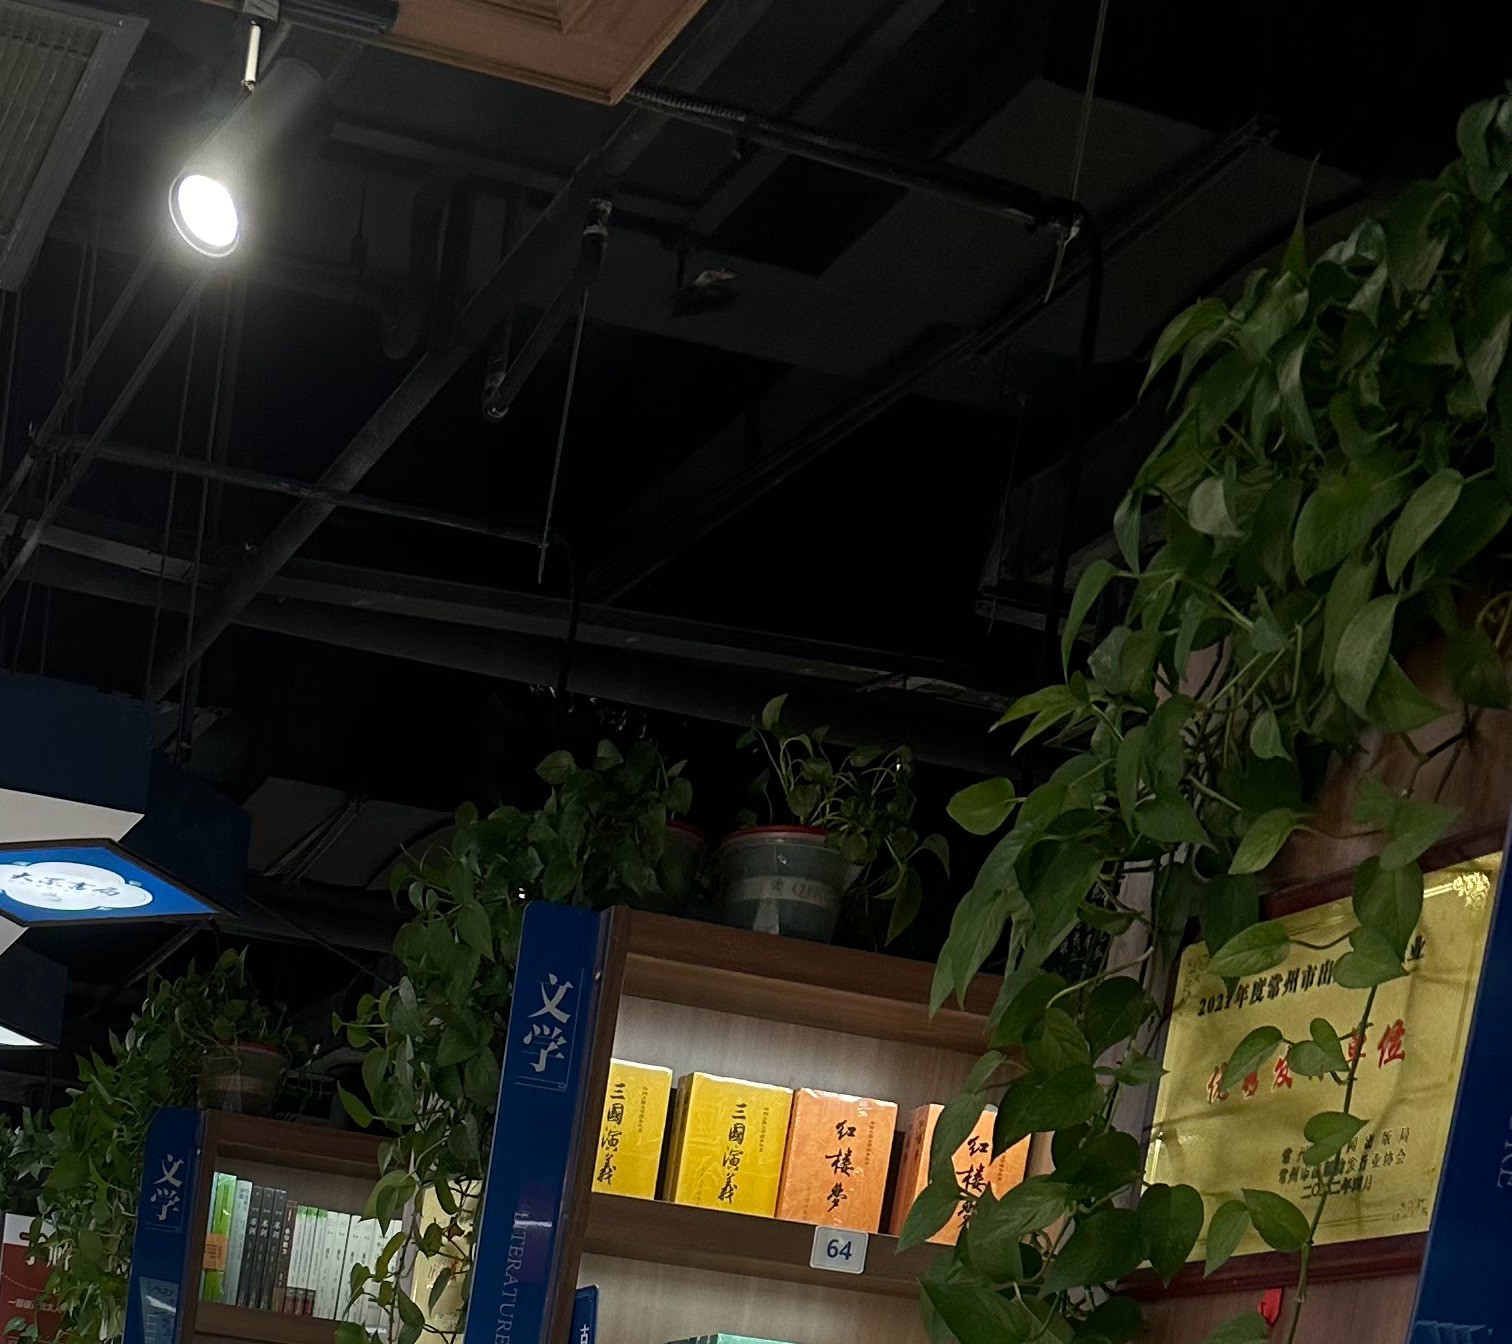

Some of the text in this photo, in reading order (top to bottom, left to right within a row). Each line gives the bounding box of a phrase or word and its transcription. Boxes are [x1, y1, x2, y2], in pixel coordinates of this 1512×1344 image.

[524, 973, 574, 1073] 文学
[151, 1153, 185, 1221] 文学
[826, 1238, 853, 1262] 64
